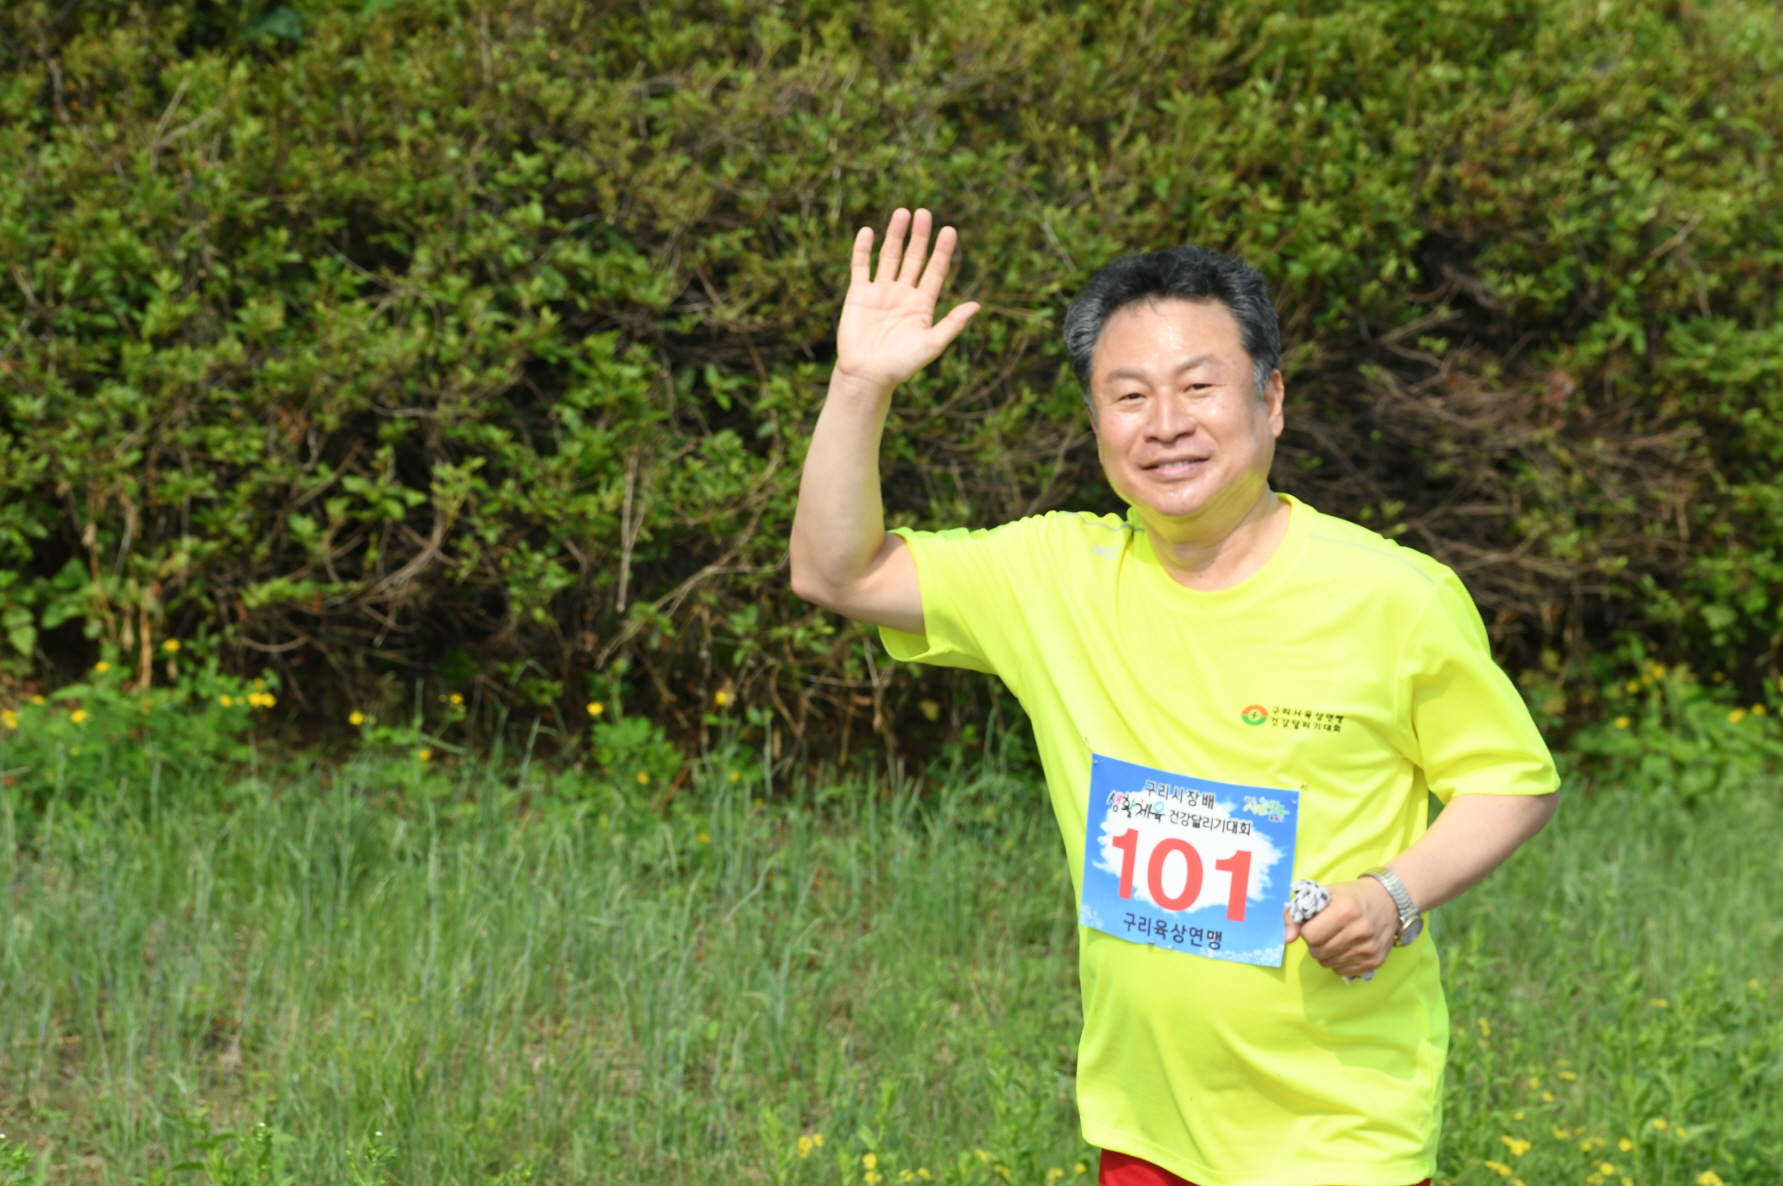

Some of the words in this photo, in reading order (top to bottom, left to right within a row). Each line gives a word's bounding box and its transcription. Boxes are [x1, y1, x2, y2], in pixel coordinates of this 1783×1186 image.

[1107, 790, 1165, 823] 생활체육
[1169, 809, 1251, 836] 건강달리기대회
[1144, 780, 1215, 809] 구리시장배
[1112, 828, 1252, 922] 101
[1123, 912, 1223, 951] 구리육상연맹
